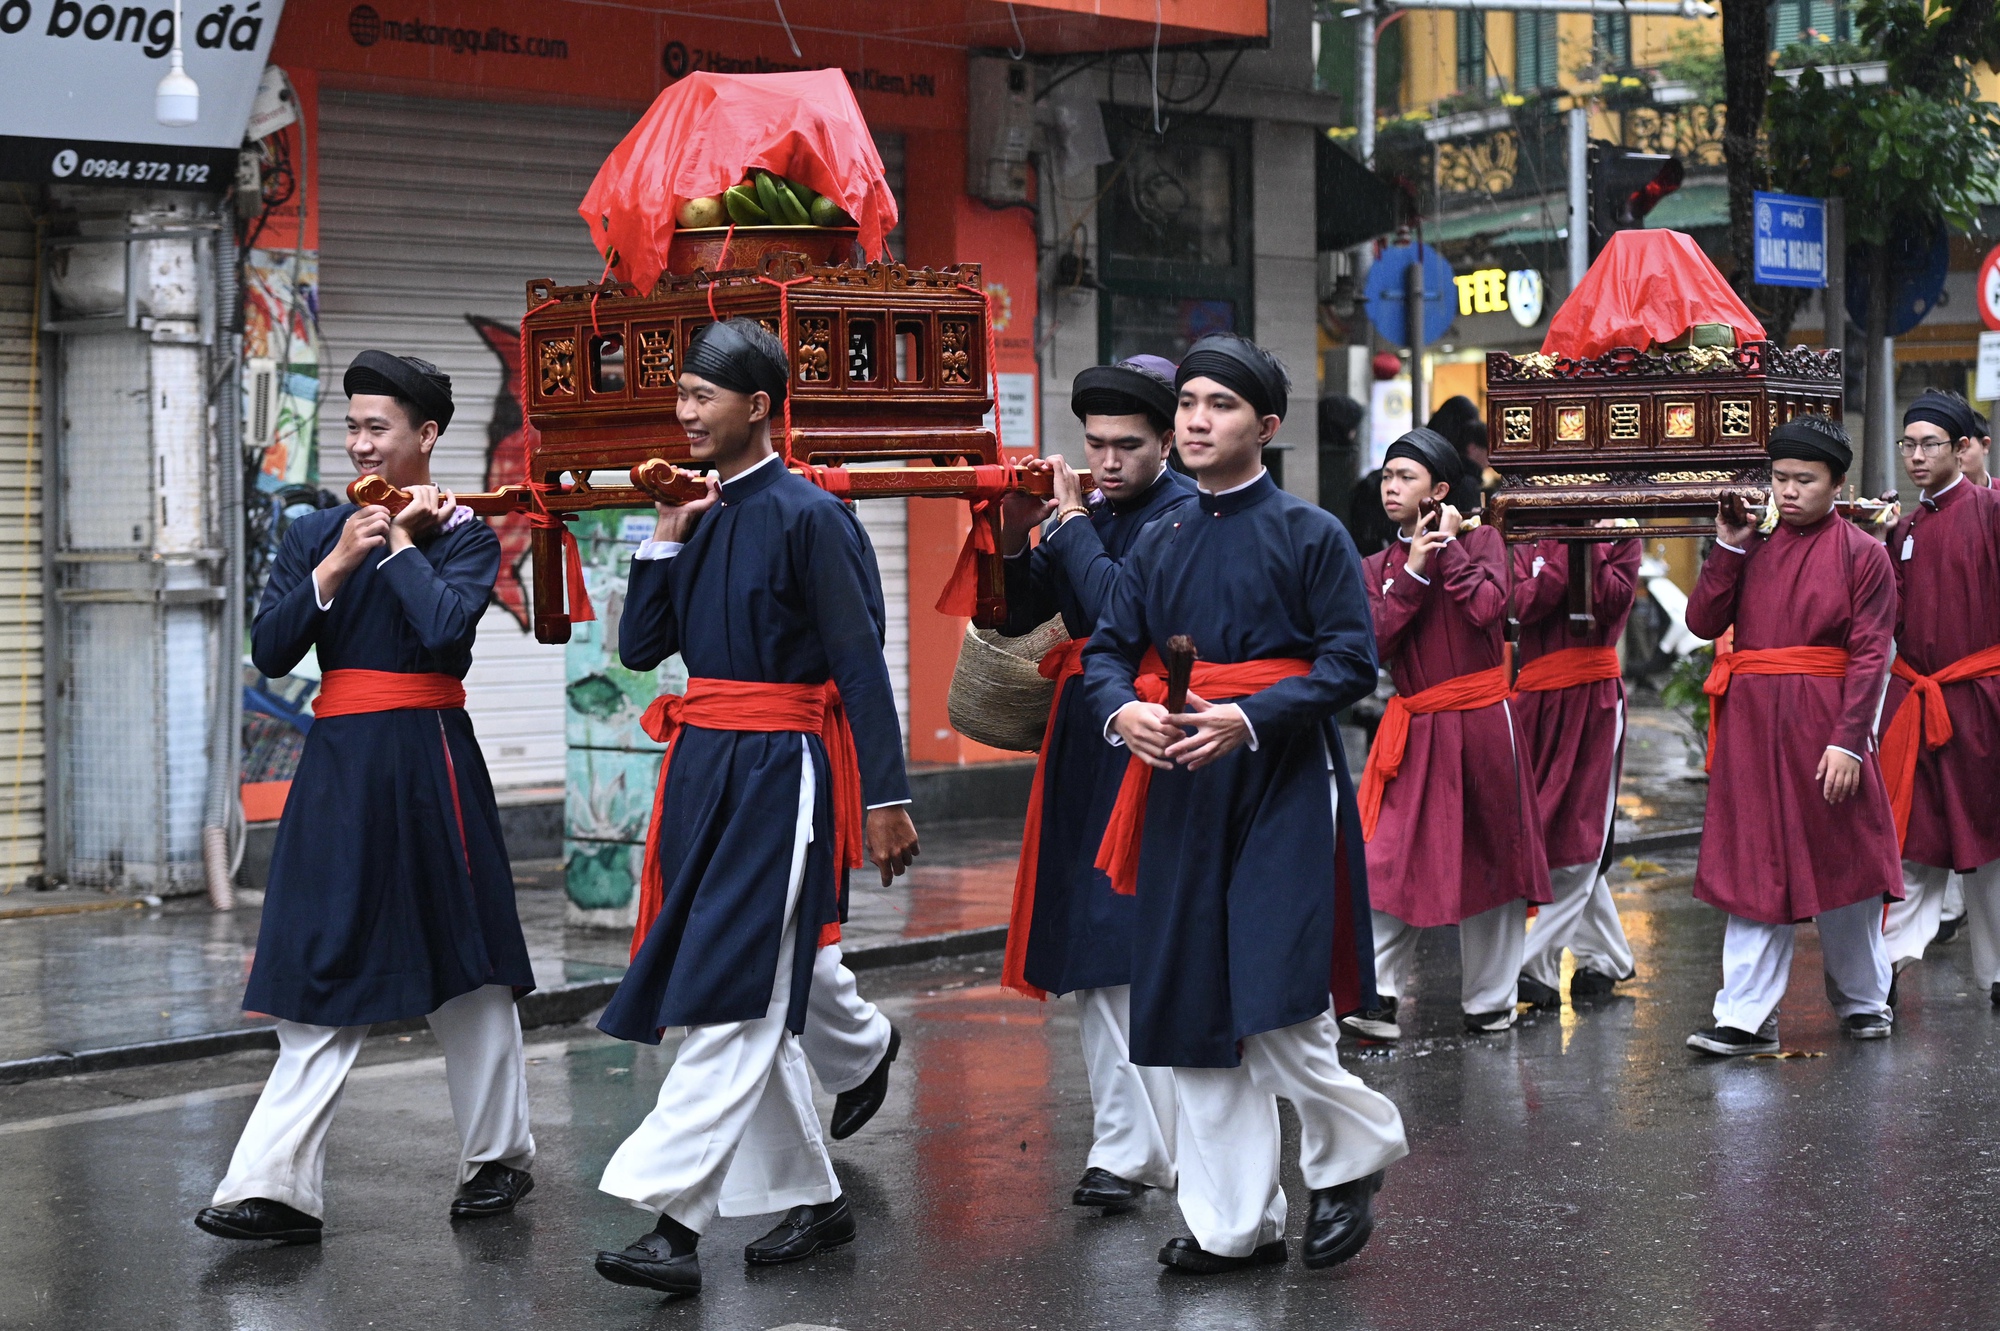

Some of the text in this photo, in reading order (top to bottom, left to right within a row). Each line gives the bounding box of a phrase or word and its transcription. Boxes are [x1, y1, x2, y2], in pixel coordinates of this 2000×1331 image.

[196, 1, 262, 51] đá
[81, 158, 210, 183] 0984 372 192
[1788, 239, 1822, 272] NGANG
